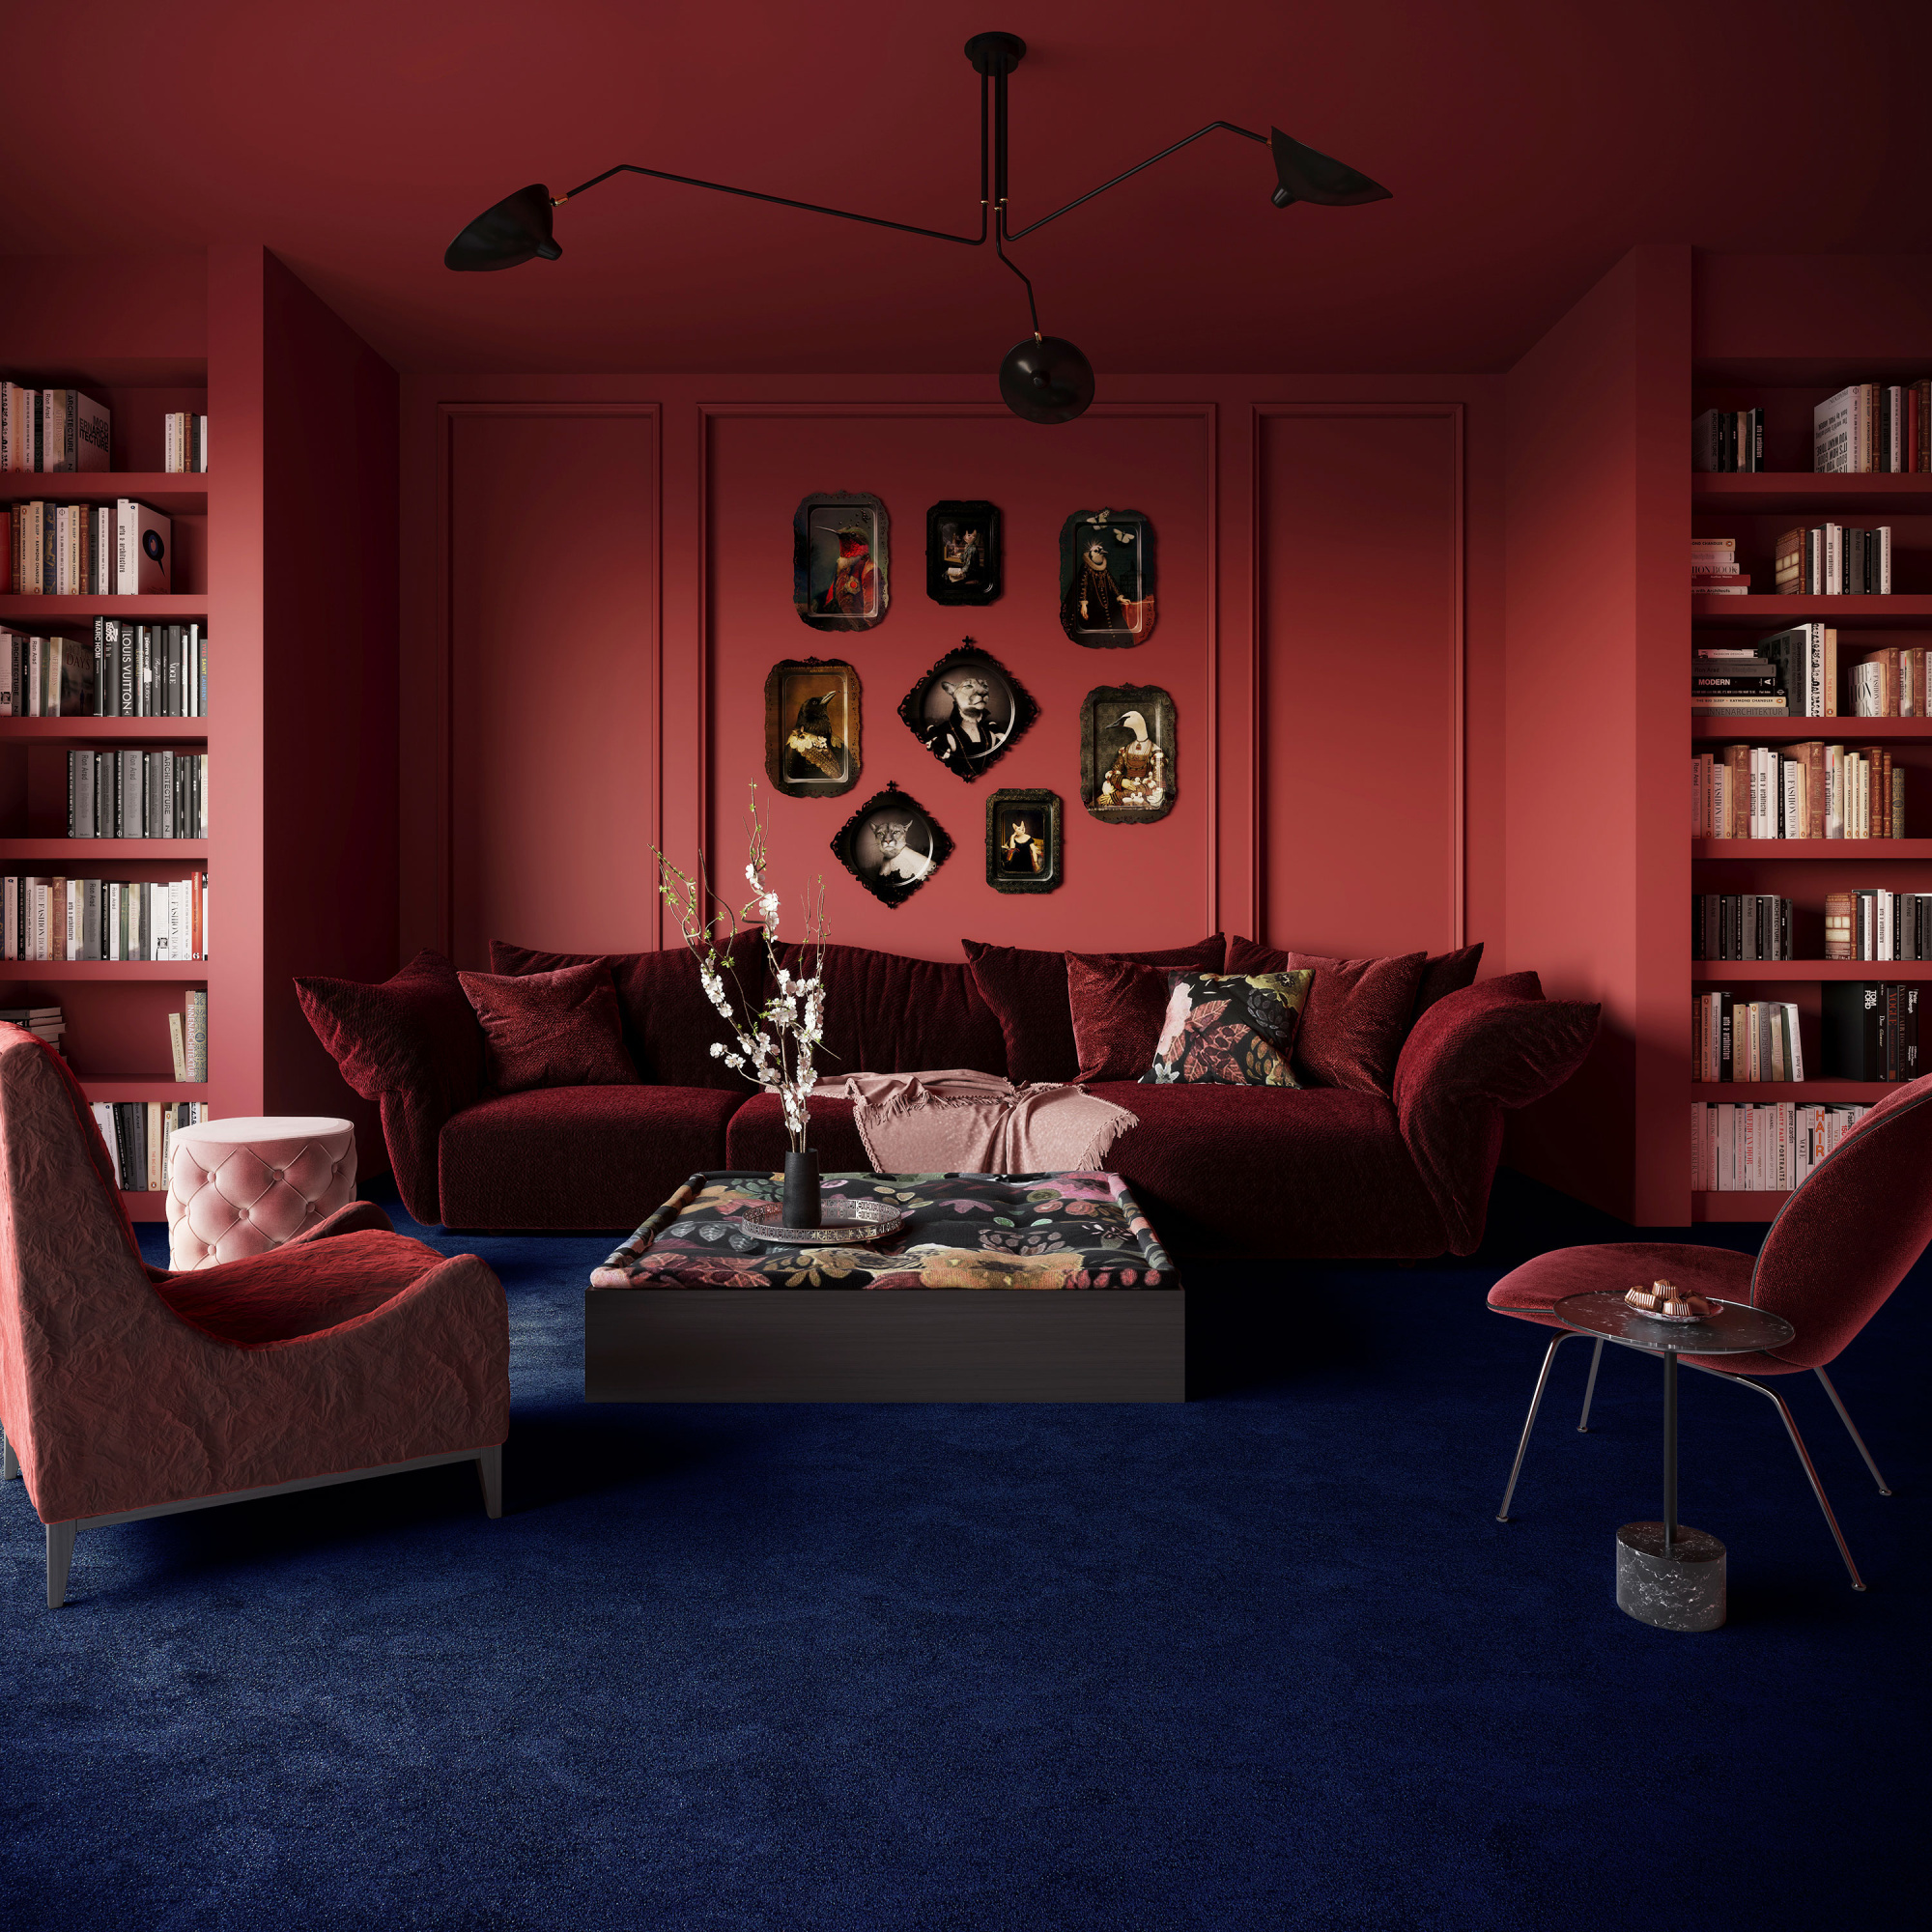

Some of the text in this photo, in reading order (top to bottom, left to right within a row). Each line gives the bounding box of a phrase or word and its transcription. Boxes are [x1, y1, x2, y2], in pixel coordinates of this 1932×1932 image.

[94, 415, 108, 431] MOD
[66, 652, 91, 670] DAYS
[122, 634, 131, 709] LOUIS VUITTON
[169, 663, 180, 684] VOGUE
[1787, 781, 1796, 814] FASHION
[1889, 993, 1897, 1026] VOGUE
[1815, 1110, 1825, 1157] HAIR
